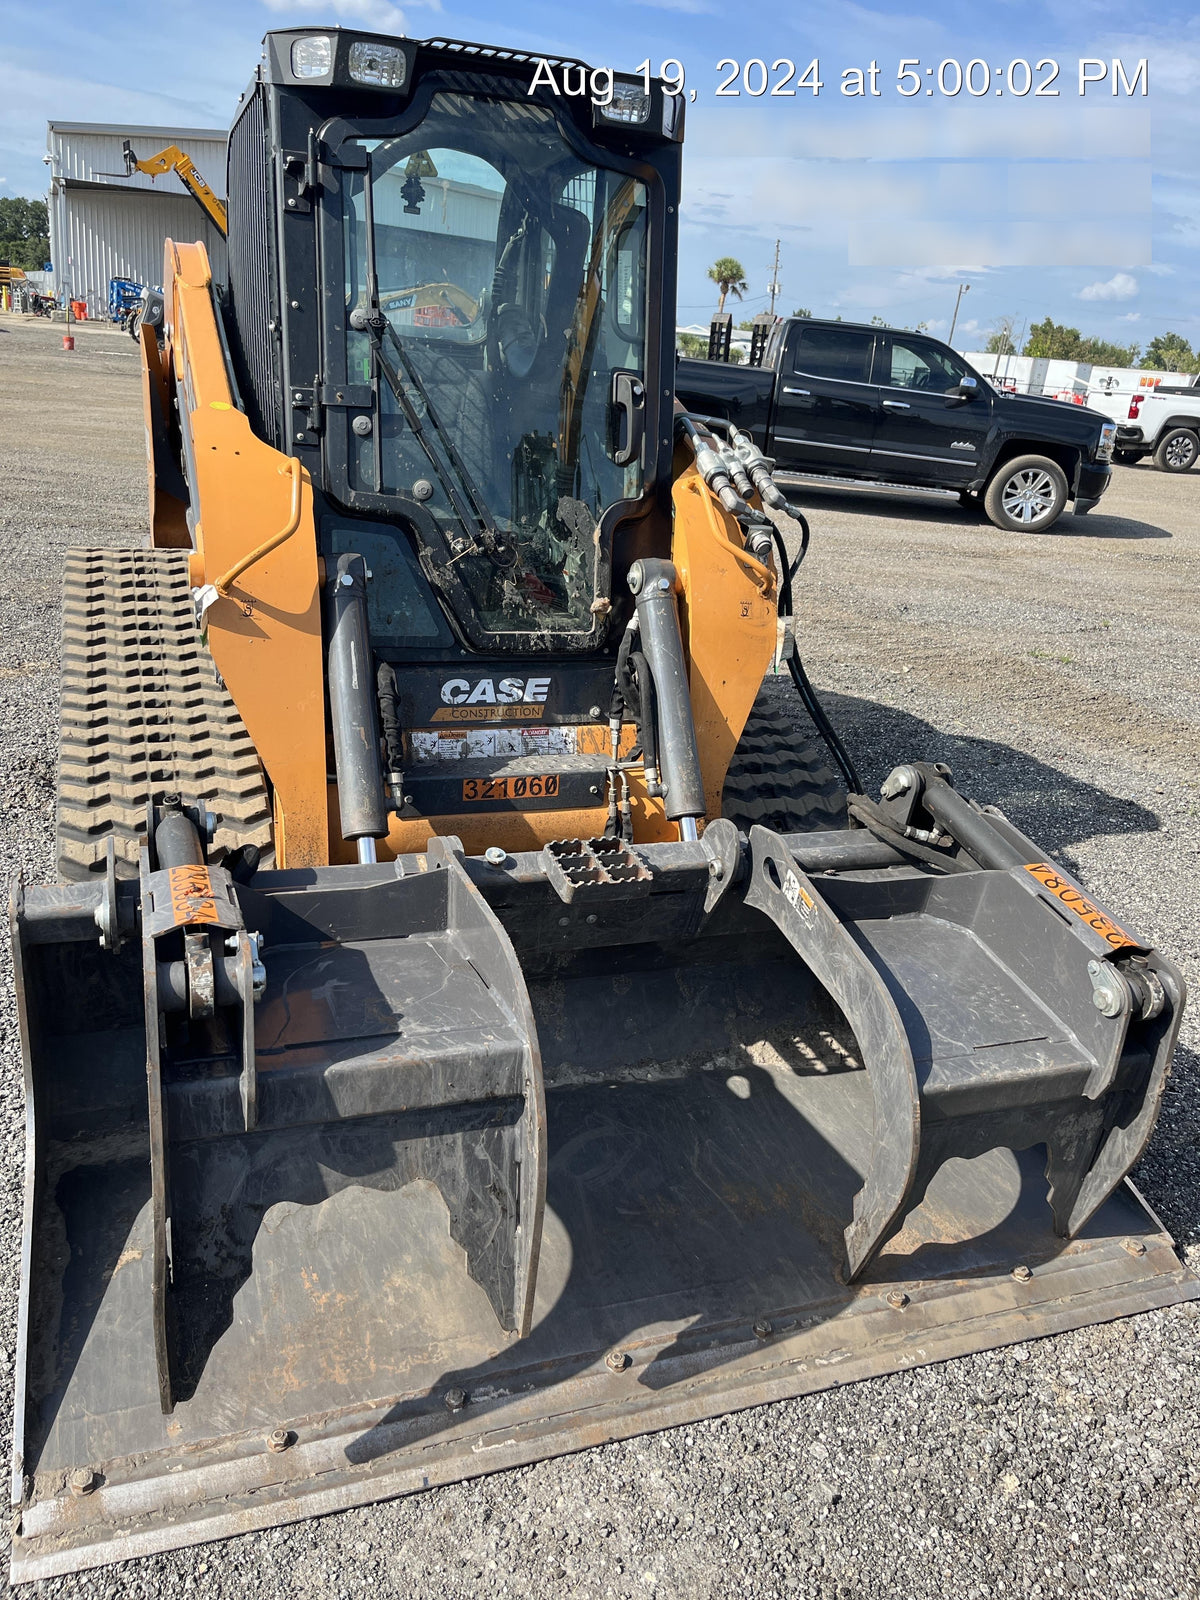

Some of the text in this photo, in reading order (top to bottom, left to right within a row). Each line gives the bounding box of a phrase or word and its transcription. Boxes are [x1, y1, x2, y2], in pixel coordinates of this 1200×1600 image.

[191, 170, 206, 187] JCB
[389, 298, 411, 309] SANY
[440, 677, 552, 704] CASE
[452, 707, 541, 719] CONSTRUCTION
[464, 775, 559, 799] 321060
